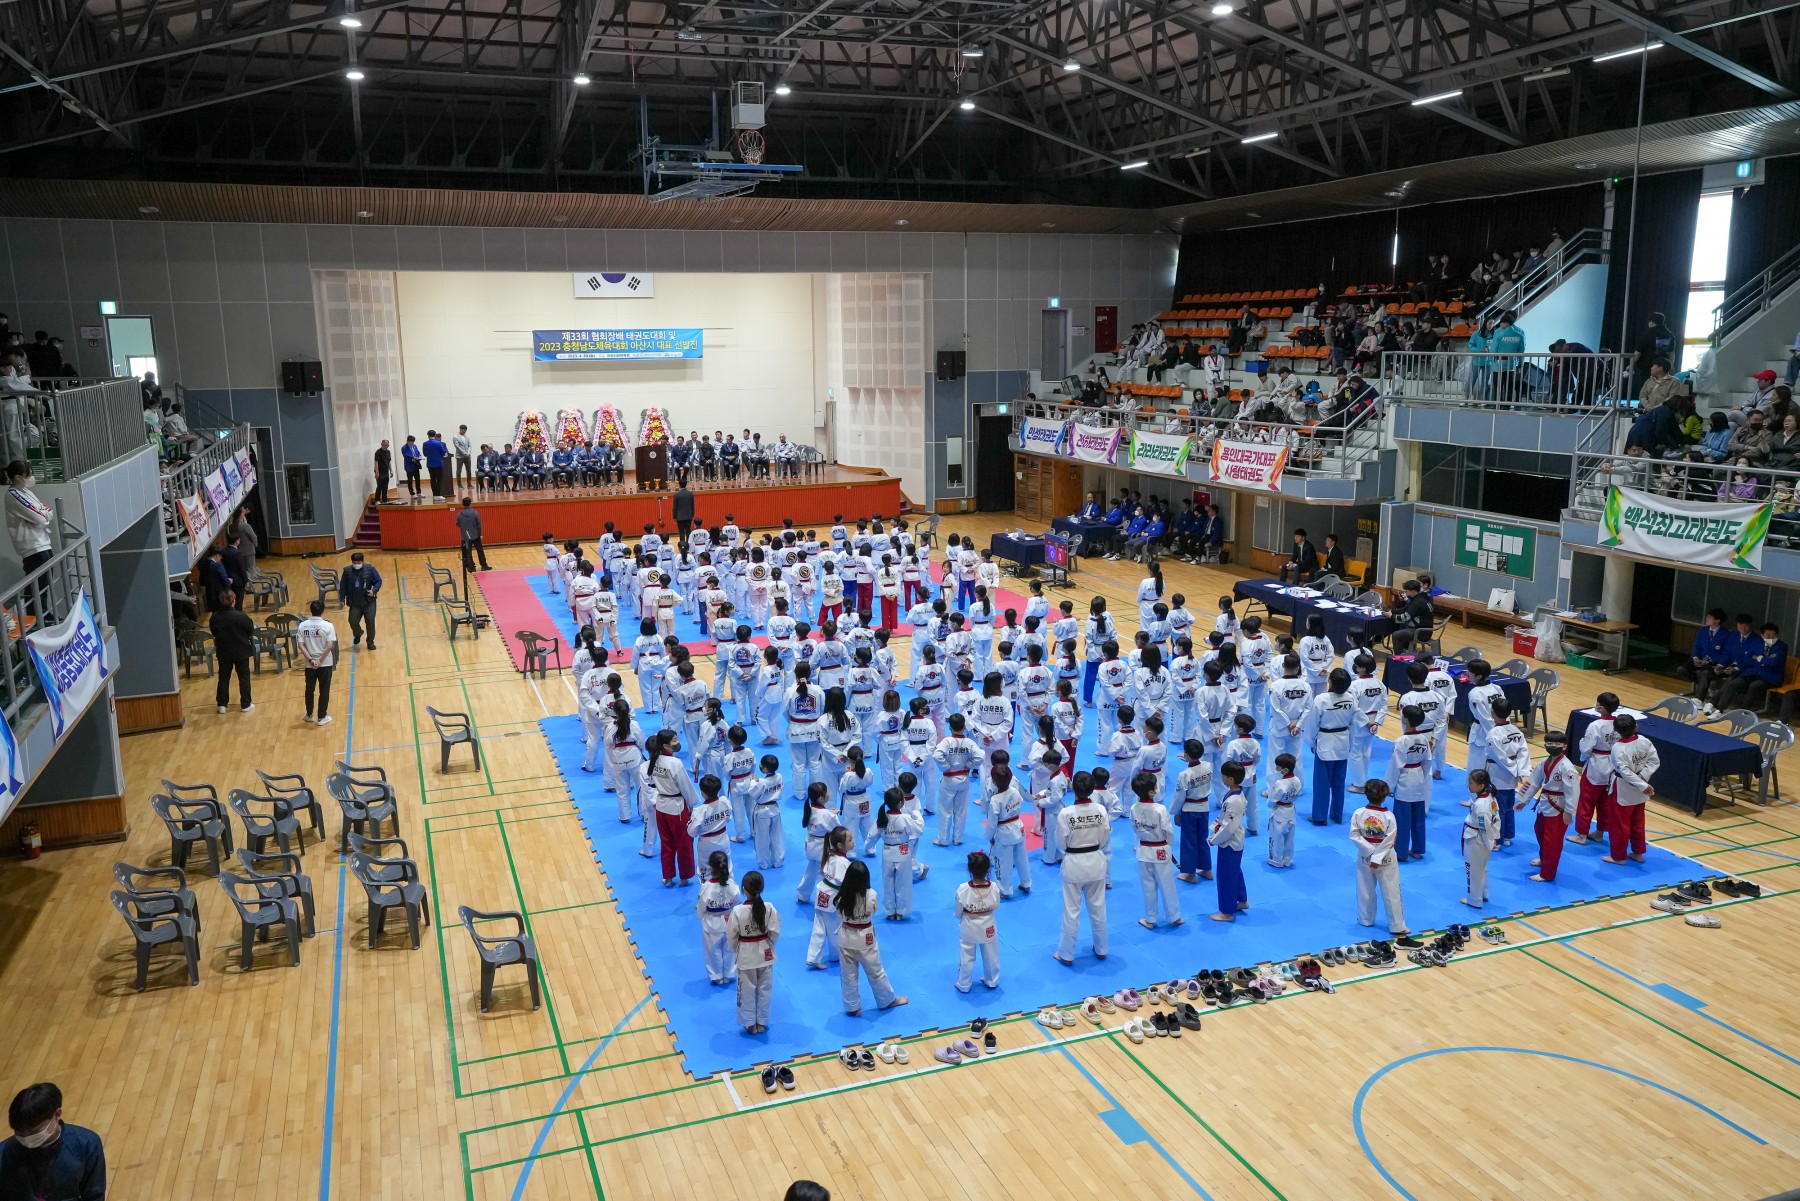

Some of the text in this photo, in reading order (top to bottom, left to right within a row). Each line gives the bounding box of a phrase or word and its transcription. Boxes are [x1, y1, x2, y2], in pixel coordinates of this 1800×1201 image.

[562, 330, 676, 341] 제33회 협회장배 태권도대회 및
[539, 339, 698, 351] 2023 충청남도체육대회 아산시 대표 선발전
[1221, 446, 1277, 466] 용인대국가대표
[1225, 464, 1265, 482] 사랑태권도
[1624, 506, 1742, 545] 백석최고태권도
[1326, 700, 1353, 711] SKY
[1502, 732, 1522, 745] SKY
[1406, 743, 1428, 755] SKY
[1069, 814, 1103, 826] 용화도장
